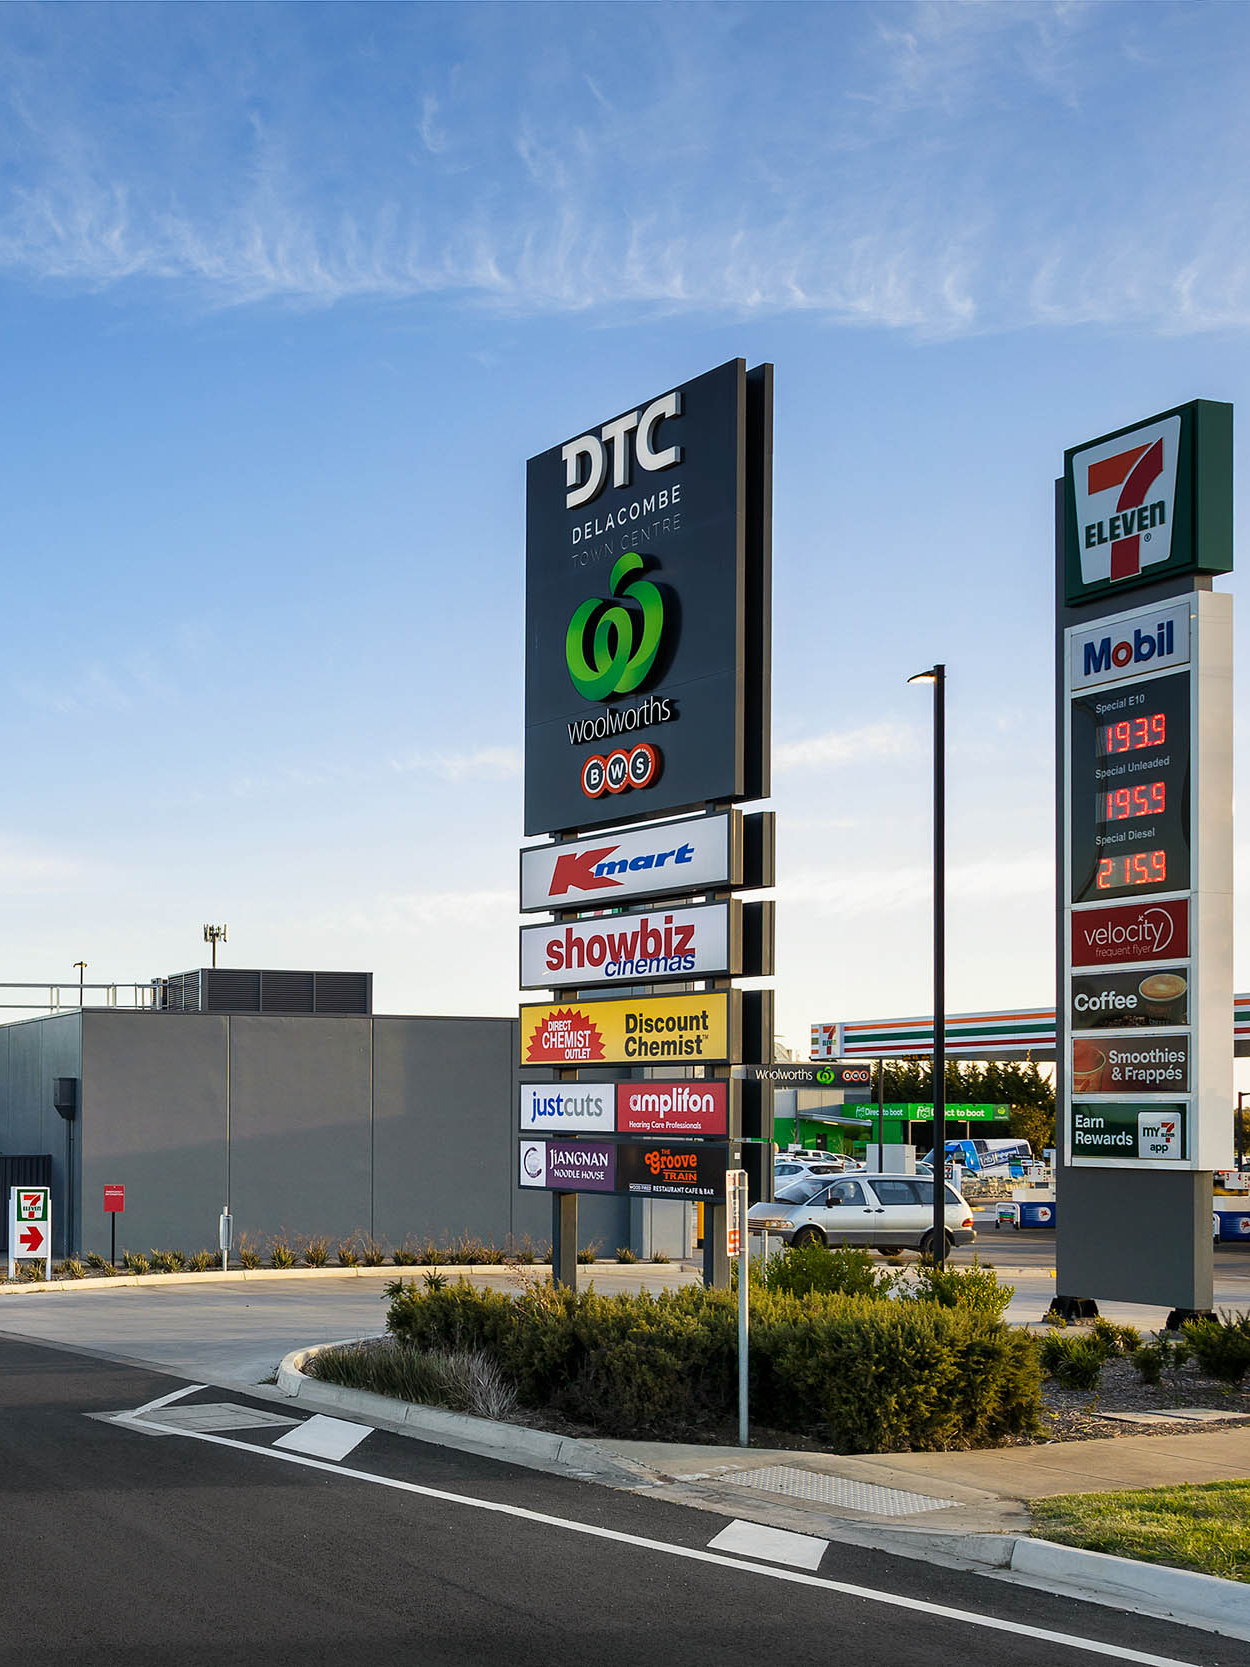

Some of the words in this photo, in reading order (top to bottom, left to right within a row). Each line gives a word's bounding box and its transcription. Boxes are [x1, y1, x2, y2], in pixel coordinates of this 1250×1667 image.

[562, 392, 682, 509] DTC
[572, 484, 681, 545] DELACOMBE
[1088, 436, 1164, 582] 7
[571, 540, 614, 568] TOWN
[620, 513, 681, 550] CENTRE
[1083, 619, 1174, 677] Mobil
[1096, 700, 1127, 714] Special
[1128, 694, 1145, 707] E10
[588, 754, 648, 788] BWS
[1095, 765, 1126, 779] Special
[1128, 756, 1170, 773] Unleaded
[1095, 833, 1126, 846] Special
[1128, 827, 1155, 841] Diesel
[548, 843, 695, 896] Kmart
[545, 915, 696, 971] showbiz
[1084, 919, 1164, 952] velocity
[1095, 946, 1130, 957] frequent
[1133, 944, 1152, 956] flyer
[604, 953, 696, 977] cinemas
[1074, 991, 1138, 1012] Coffee
[548, 1020, 572, 1031] DIRECT
[625, 1010, 709, 1034] Discount
[542, 1031, 591, 1049] CHEMIST
[624, 1034, 703, 1057] Chemist
[823, 1026, 836, 1055] 7
[564, 1048, 591, 1059] OUTLET
[1109, 1048, 1186, 1064] Smoothies
[1111, 1066, 1123, 1081] &
[1125, 1064, 1183, 1085] Frappés
[629, 1087, 715, 1119] amplifon
[890, 1108, 903, 1116] boot
[956, 1109, 966, 1117] to
[966, 1109, 985, 1117] boot
[629, 1121, 650, 1130] Hearing
[651, 1121, 665, 1129] Care
[666, 1121, 702, 1129] Professionals
[1075, 1114, 1104, 1128] Earn
[1075, 1131, 1134, 1146] Rewards
[1150, 1144, 1169, 1154] app
[554, 1169, 581, 1179] NOODLE
[581, 1171, 605, 1180] HOUSE
[663, 1172, 697, 1181] TRAIN
[653, 1185, 684, 1193] RESTAURANT
[685, 1186, 698, 1194] CAFE
[23, 1194, 41, 1218] 7
